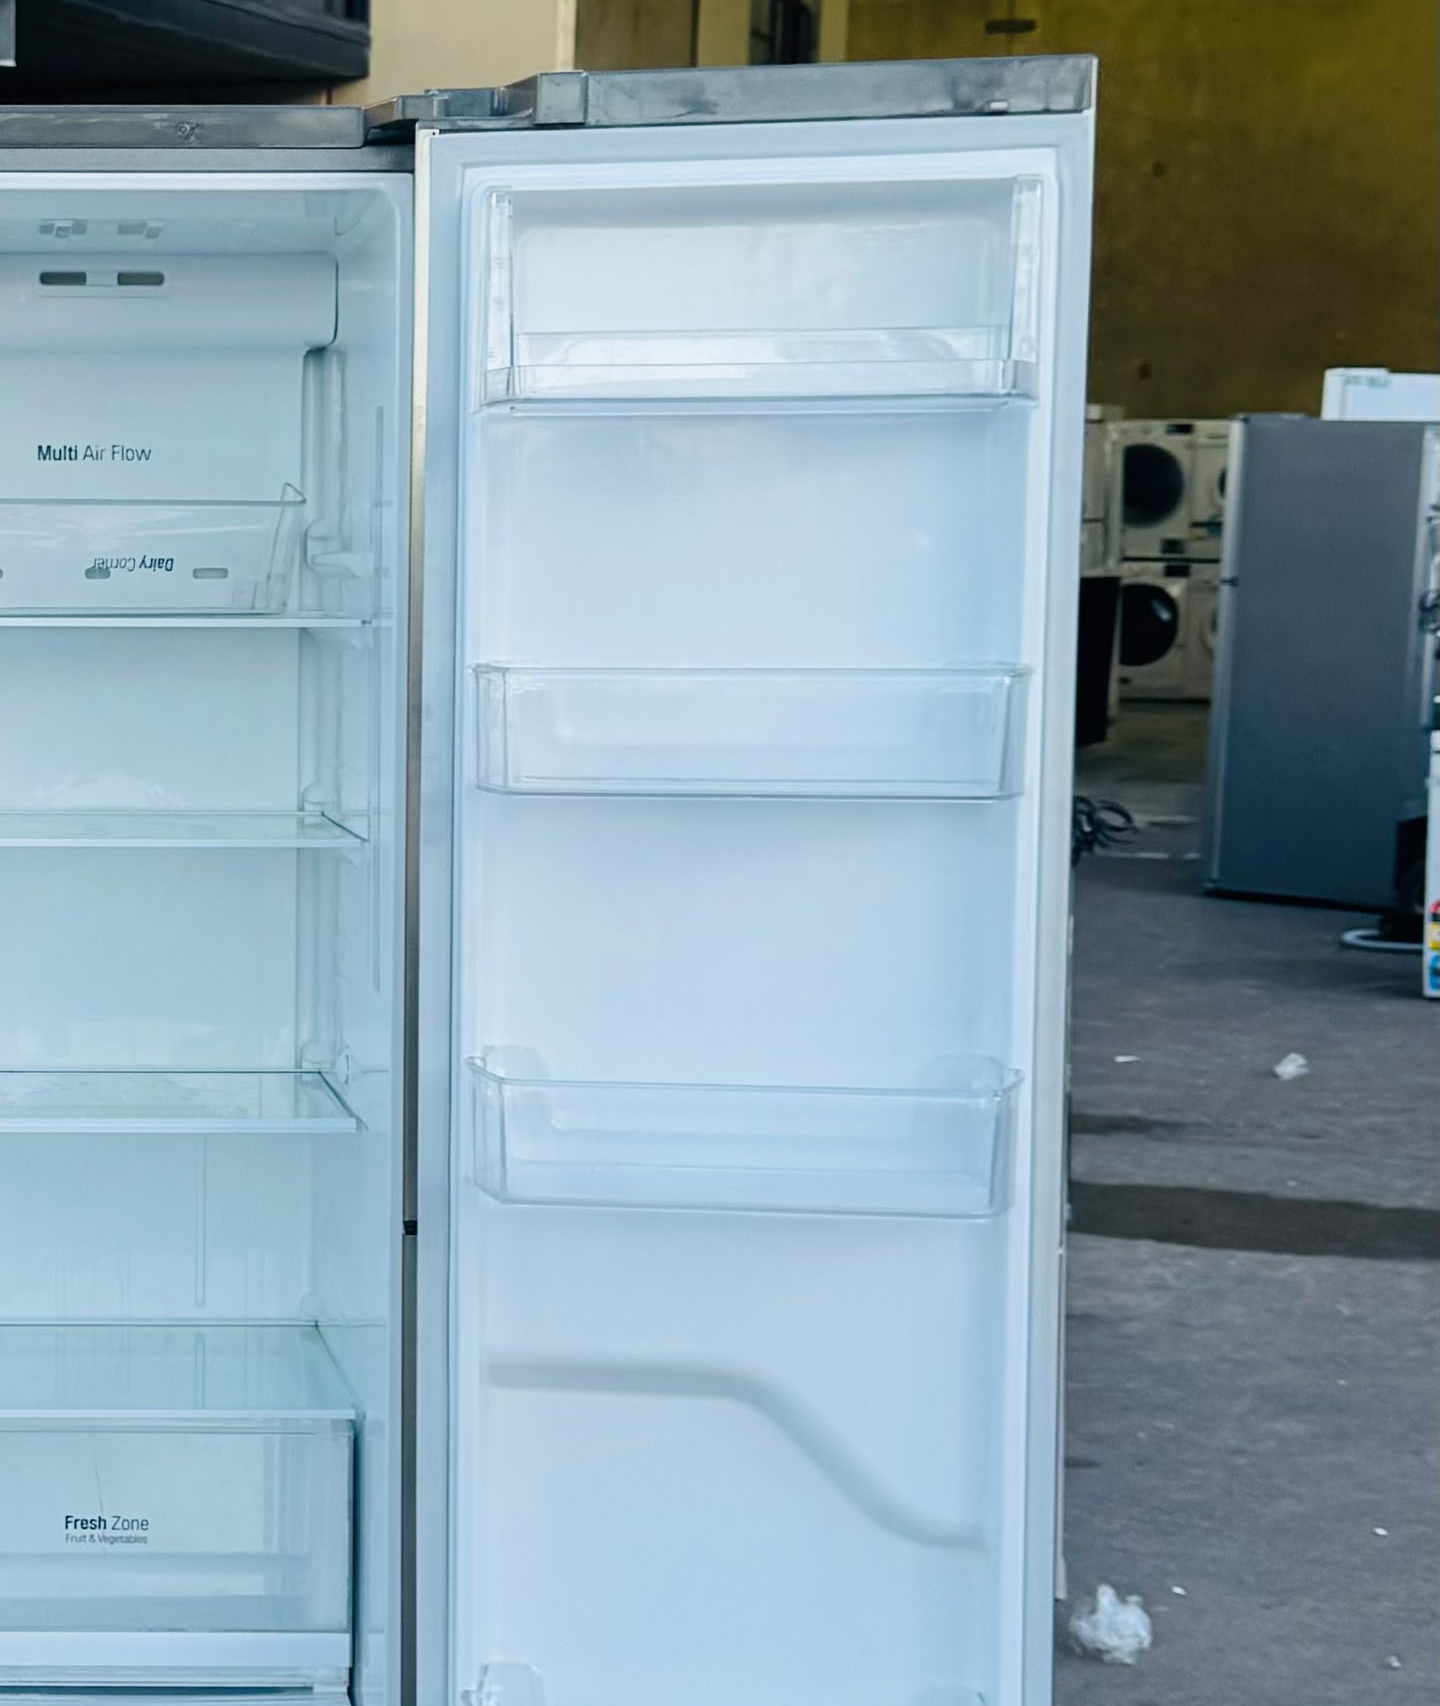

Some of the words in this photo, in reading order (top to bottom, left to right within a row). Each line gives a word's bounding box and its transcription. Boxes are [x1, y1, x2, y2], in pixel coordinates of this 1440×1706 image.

[38, 444, 78, 461] Multi
[83, 444, 105, 461] Air
[112, 444, 152, 461] Flow
[94, 557, 136, 572] Corner
[139, 555, 175, 572] Dairy
[65, 1515, 107, 1530] Fresh
[111, 1515, 149, 1531] Zone
[65, 1533, 87, 1543] Fruit
[88, 1533, 97, 1543] &
[97, 1533, 148, 1545] Vegetables
